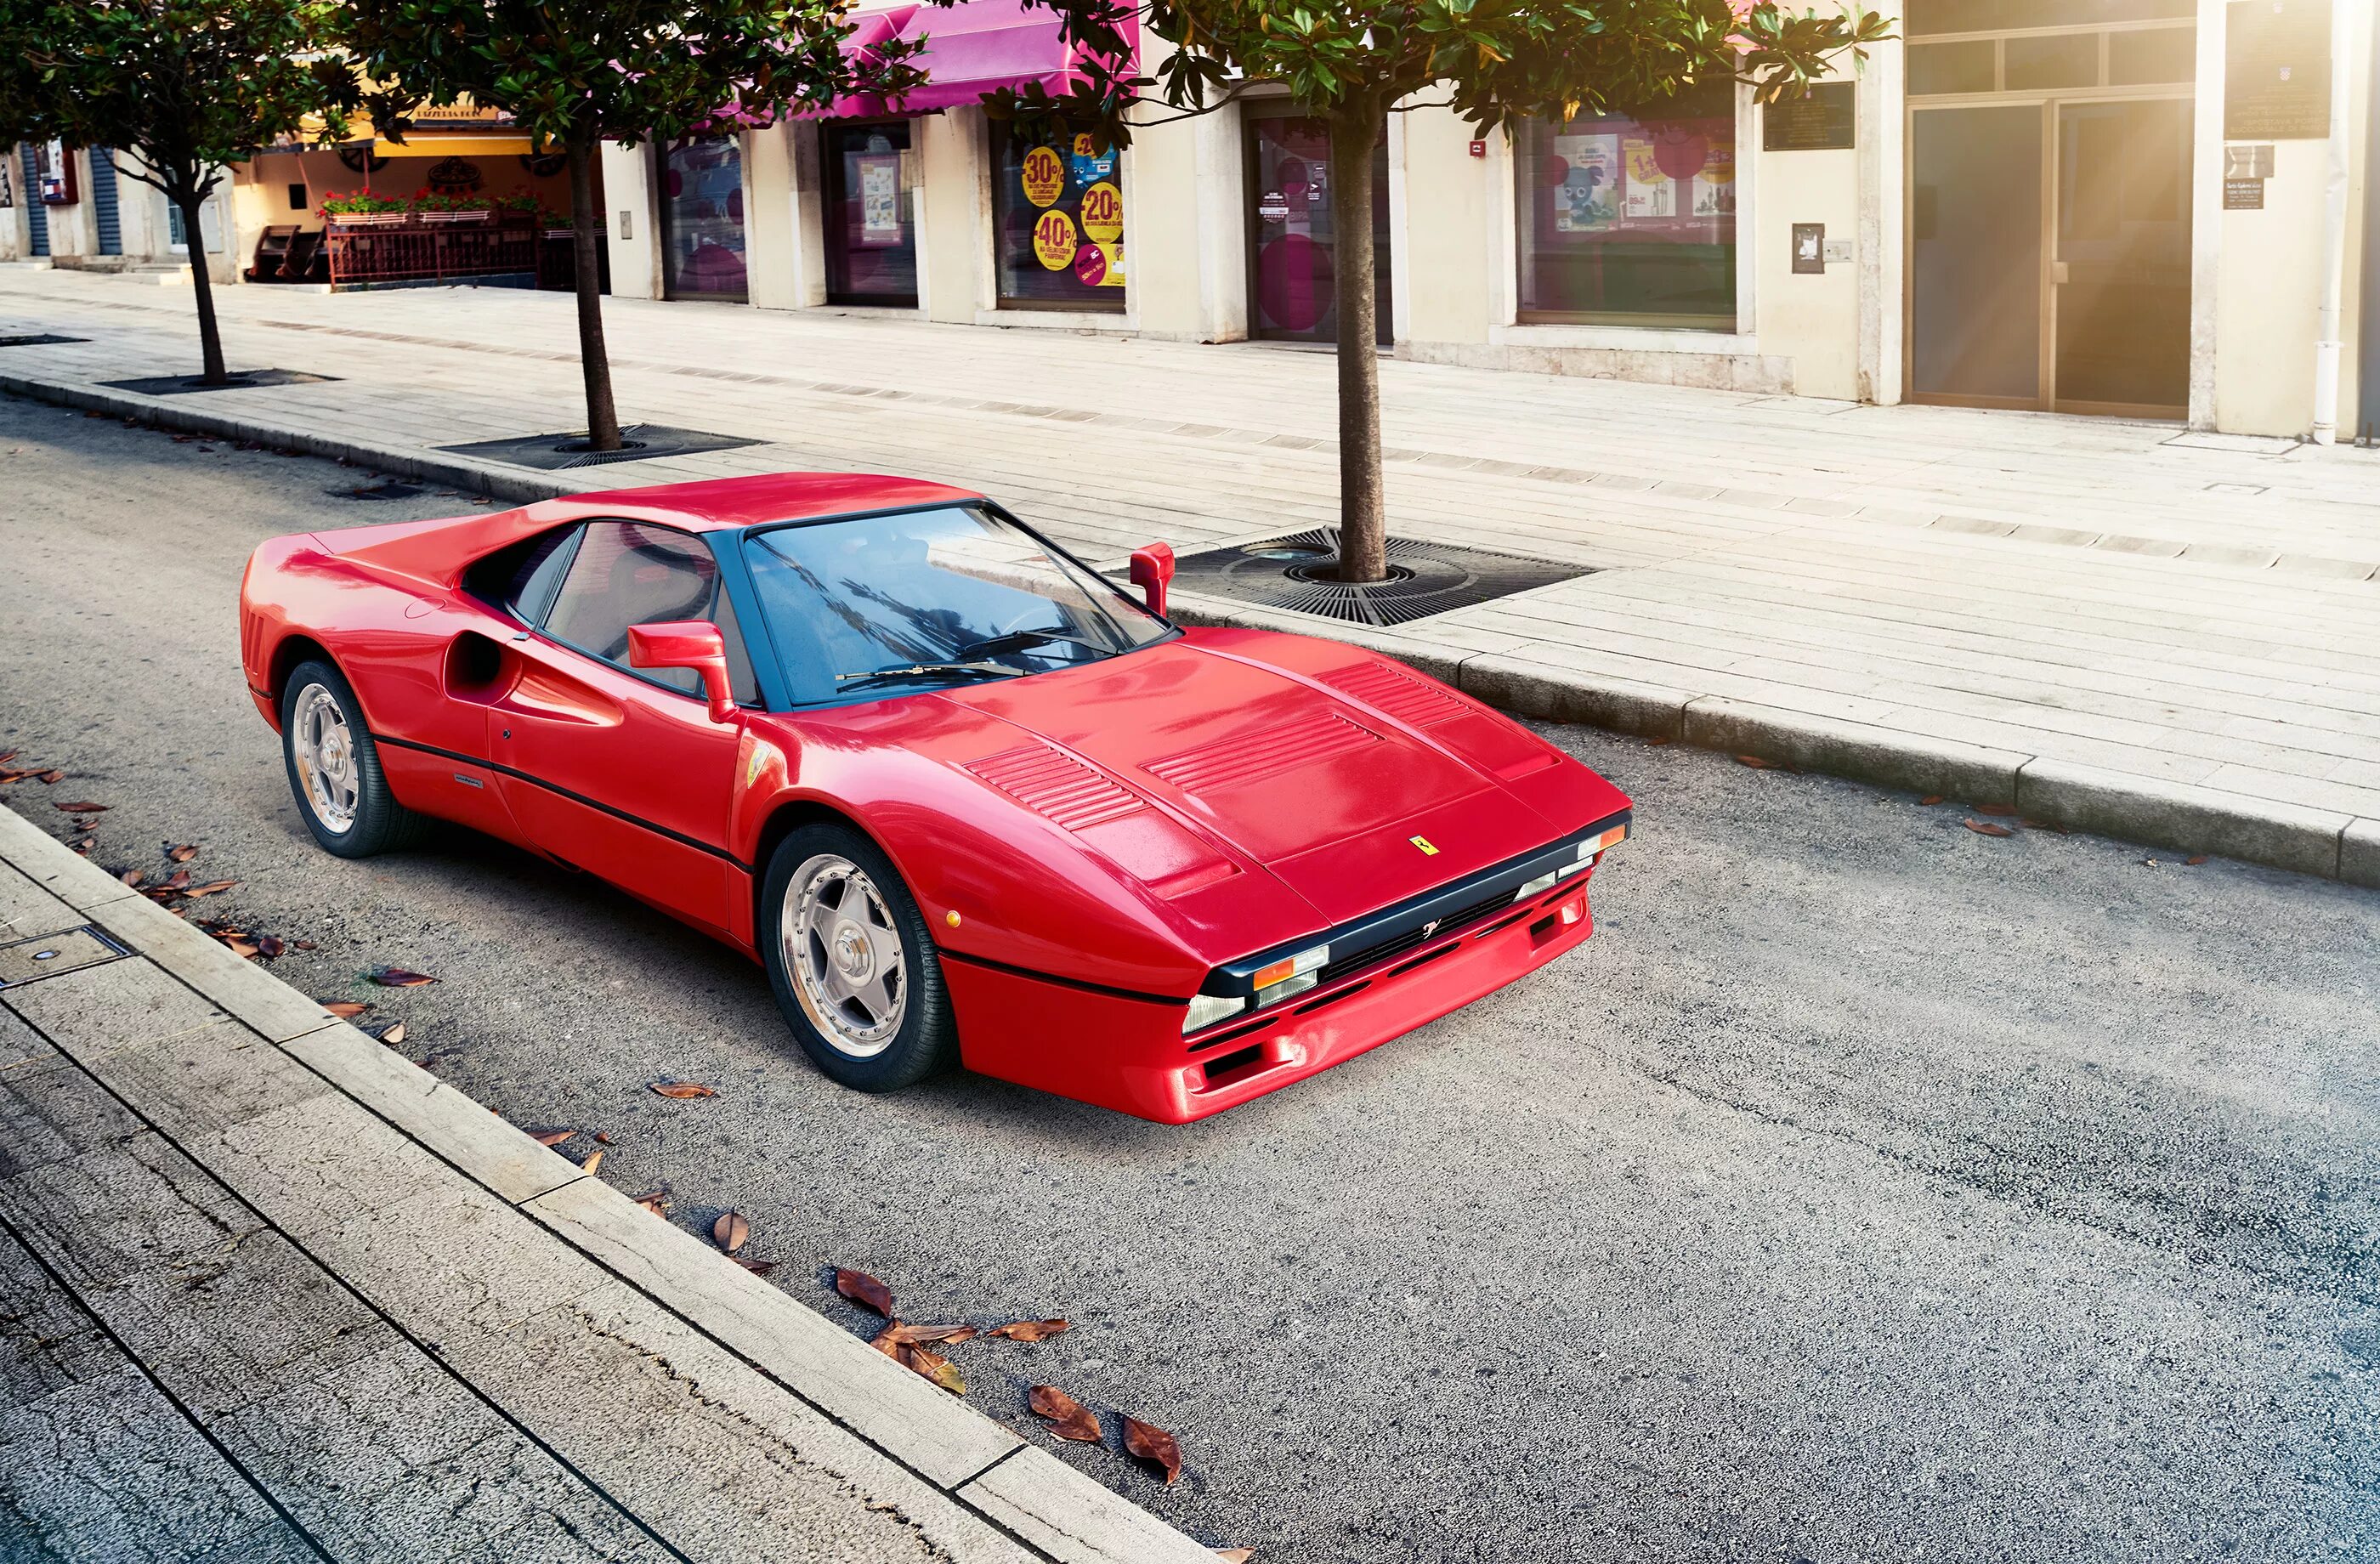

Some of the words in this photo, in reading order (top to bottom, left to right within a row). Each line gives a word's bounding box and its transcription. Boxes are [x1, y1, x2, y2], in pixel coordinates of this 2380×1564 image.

[1021, 153, 1065, 184] -30%
[1289, 211, 1309, 221] BIPA
[1034, 216, 1078, 248] -40%
